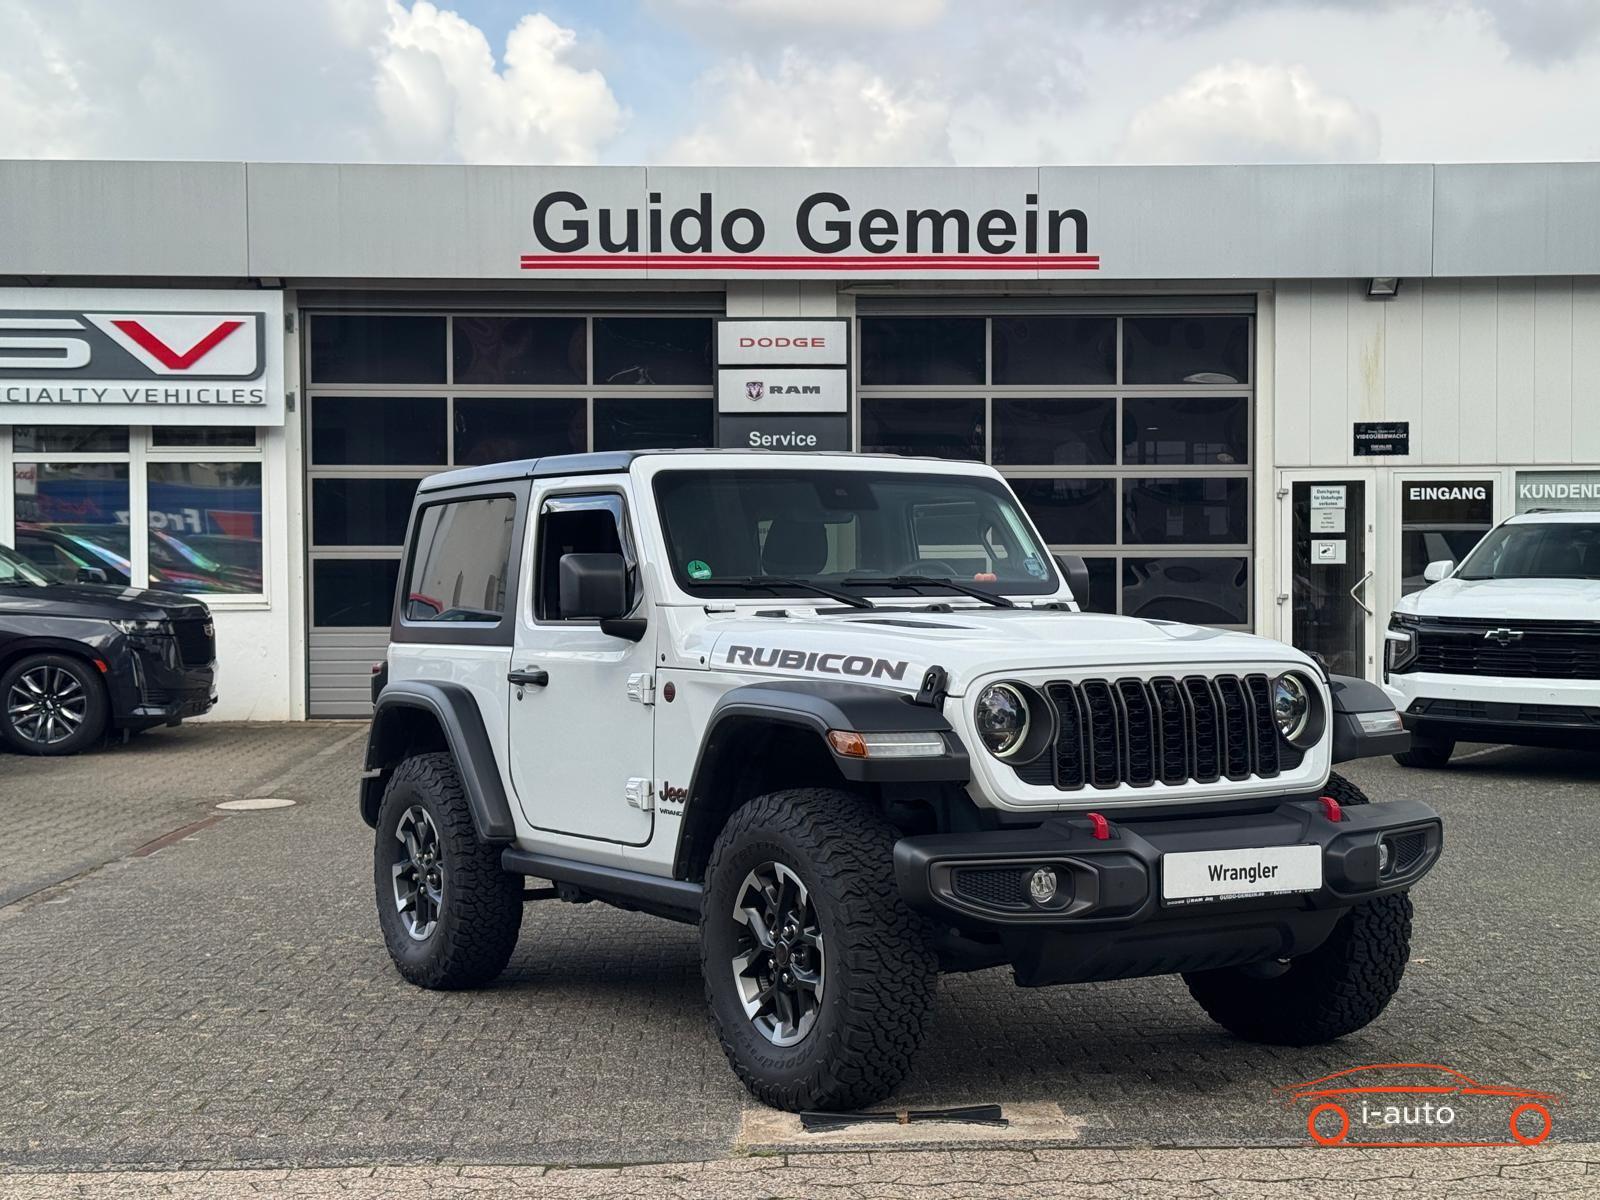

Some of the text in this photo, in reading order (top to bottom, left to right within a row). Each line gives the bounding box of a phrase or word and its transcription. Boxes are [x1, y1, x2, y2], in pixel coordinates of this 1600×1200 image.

[533, 191, 1088, 255] Guido Gemein
[740, 338, 826, 347] DODGE
[122, 388, 263, 404] VEHICLES
[769, 386, 821, 394] RAM
[749, 431, 817, 446] Service
[1409, 487, 1487, 500] EINGANG
[726, 645, 909, 681] RUBICON
[659, 781, 688, 804] Jee
[1208, 862, 1278, 884] Wrangler
